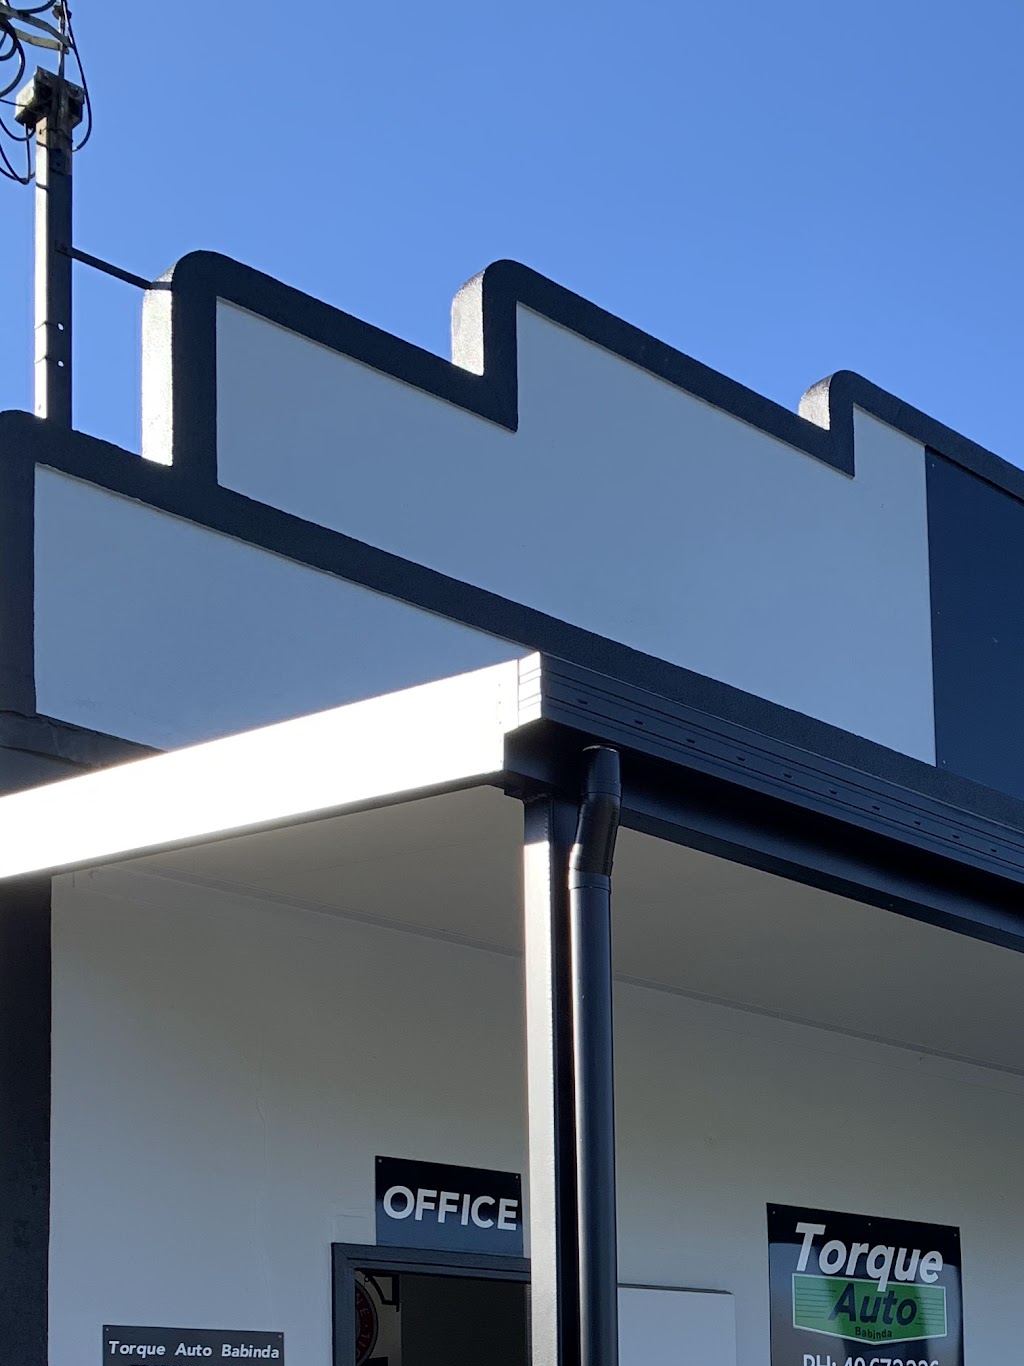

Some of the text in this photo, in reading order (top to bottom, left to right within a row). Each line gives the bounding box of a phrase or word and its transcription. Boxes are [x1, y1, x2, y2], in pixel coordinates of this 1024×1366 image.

[383, 1185, 518, 1231] OFFICE
[795, 1222, 943, 1292] Torque
[828, 1283, 917, 1325] Auto
[108, 1340, 279, 1359] Torque Auto Babinda
[855, 1326, 892, 1339] Babinda
